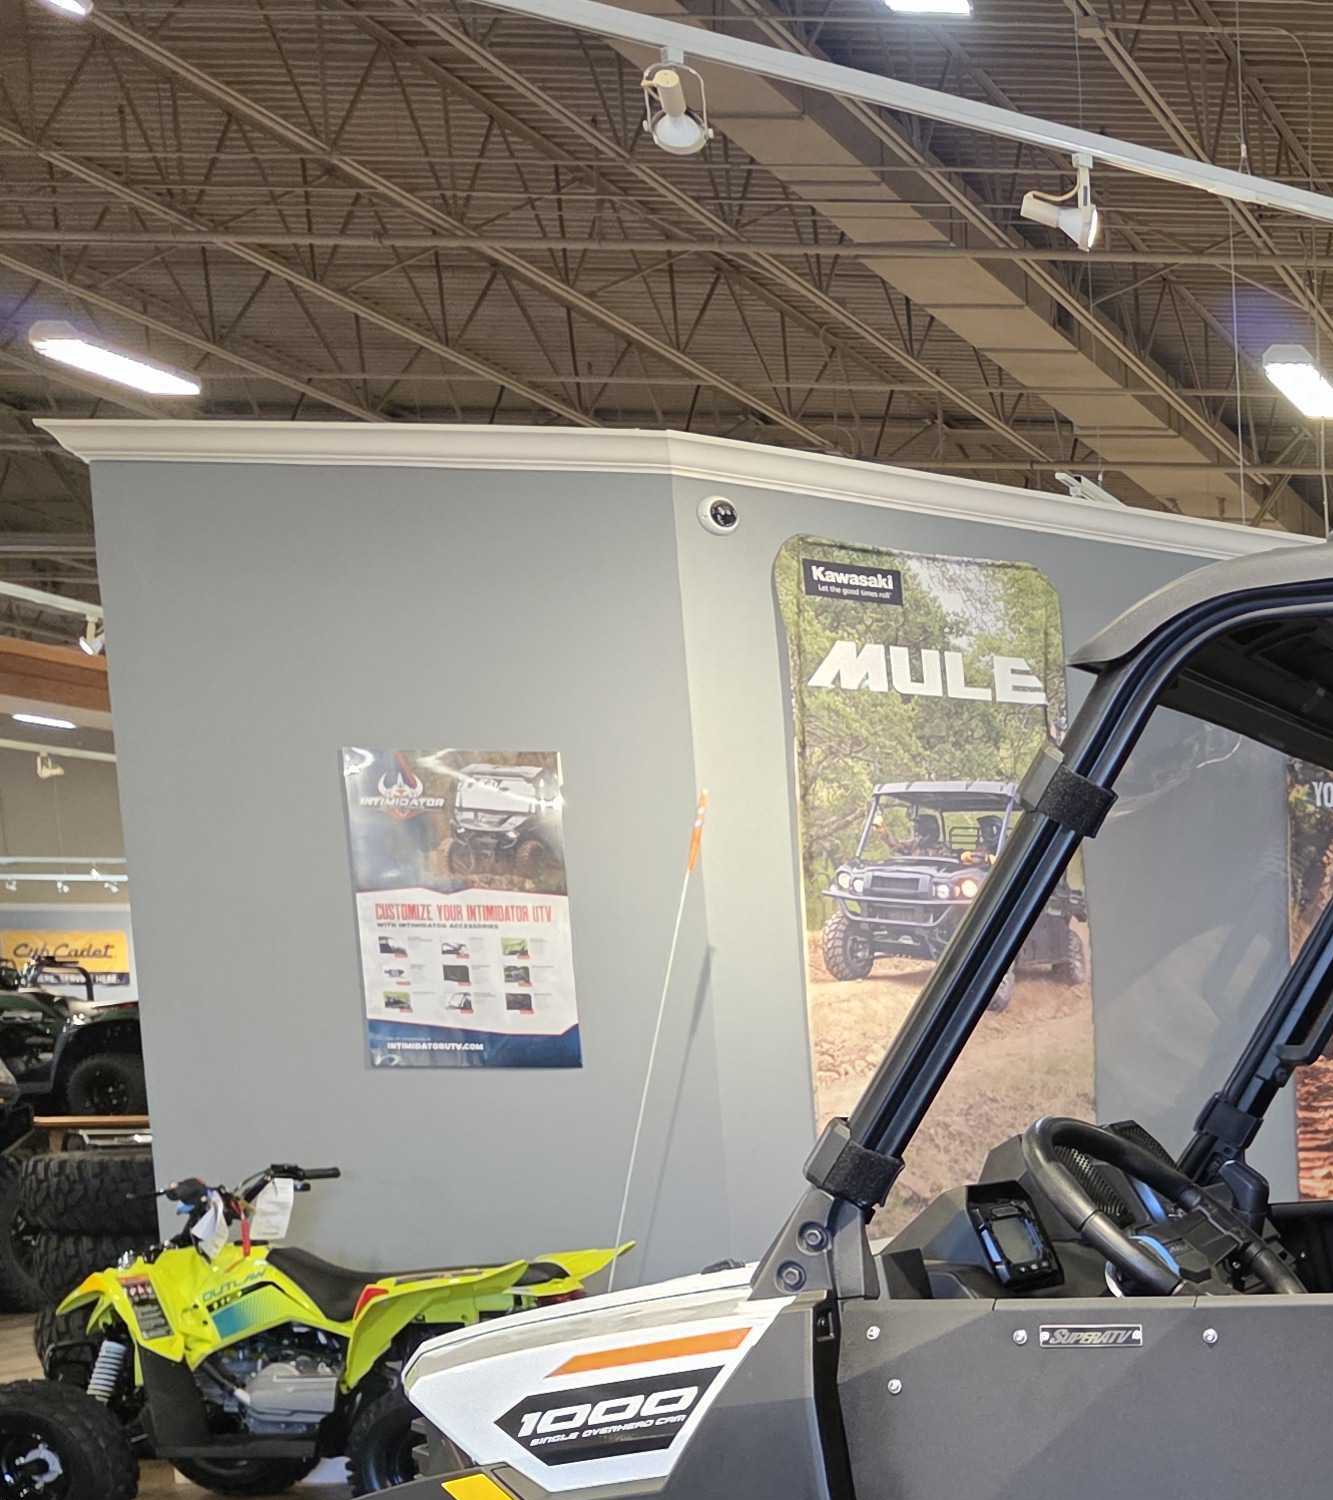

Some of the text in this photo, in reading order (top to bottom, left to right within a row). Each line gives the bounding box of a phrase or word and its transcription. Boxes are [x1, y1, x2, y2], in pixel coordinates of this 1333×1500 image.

[811, 565, 893, 590] Kawasaki
[818, 584, 829, 592] Let
[829, 585, 841, 594] the
[842, 587, 859, 596] good
[860, 589, 878, 598] times
[808, 640, 1048, 705] MULE
[360, 796, 444, 808] INTIMIDATOR
[375, 903, 552, 922] CUSTOMIZE YOUR INTIMIDATOR UTV
[54, 943, 114, 959] Cadet
[518, 1386, 699, 1438] 1000
[530, 1414, 688, 1447] SINGLE OVERHEAD CAM
